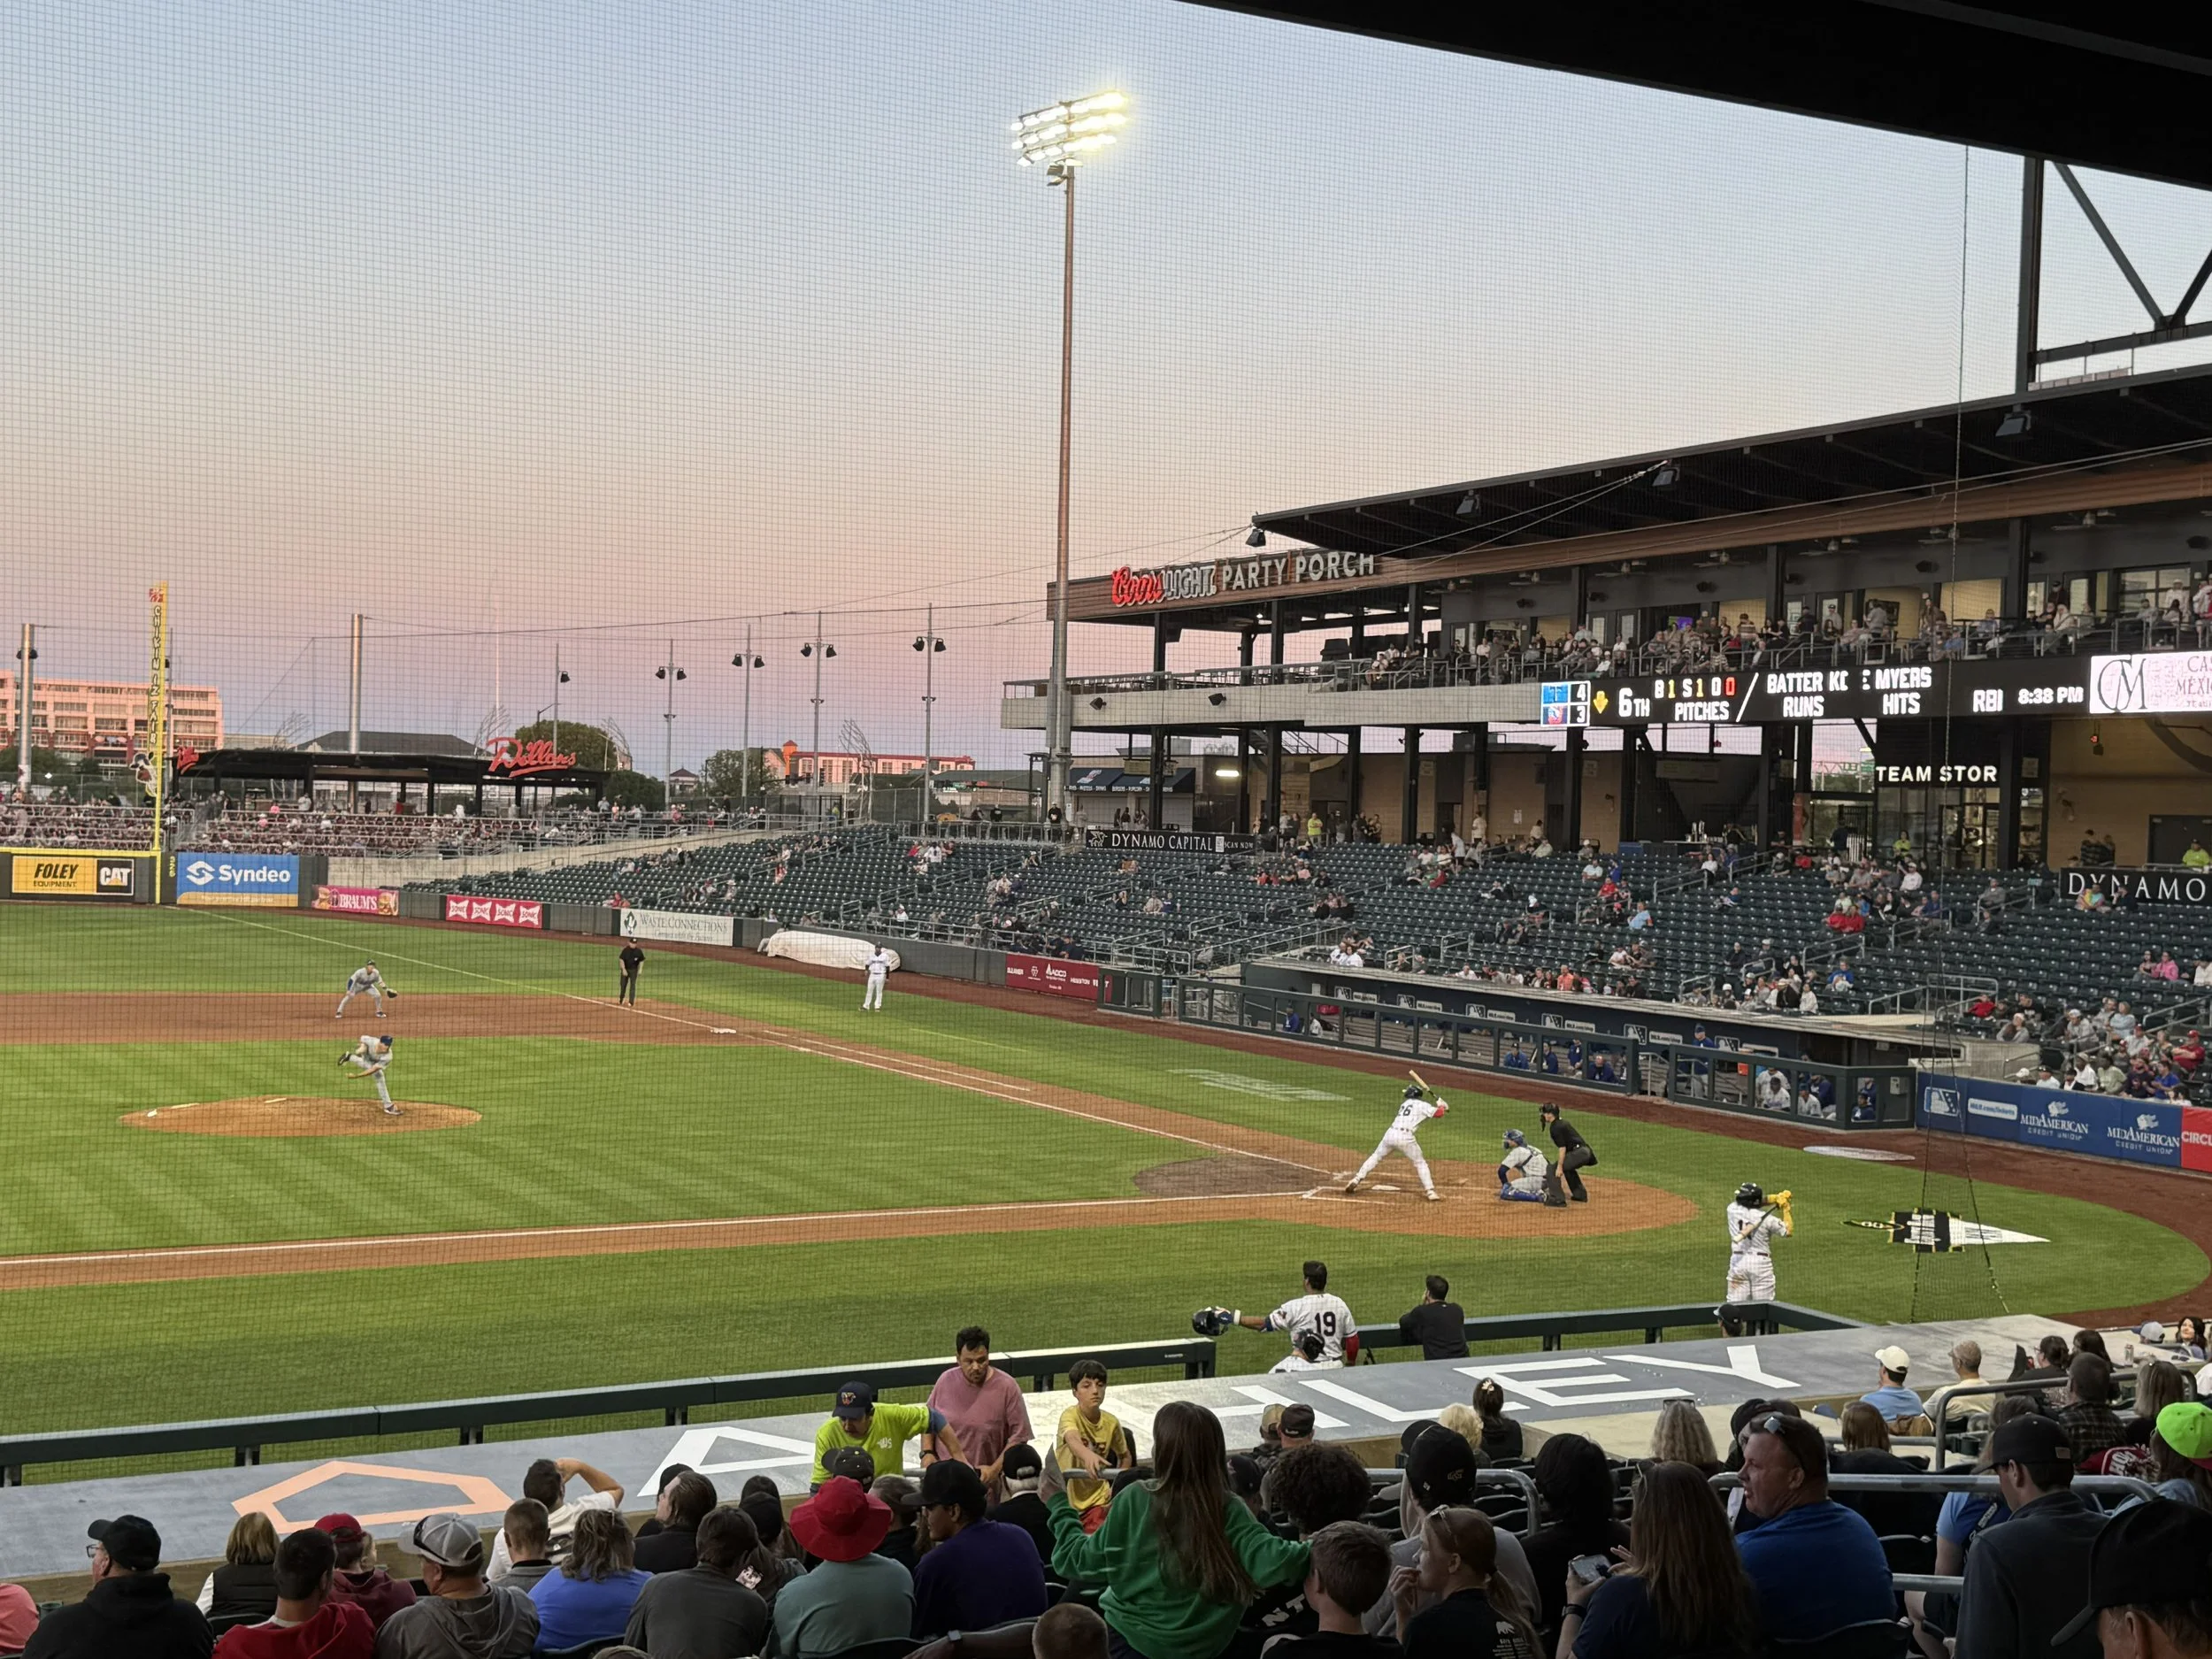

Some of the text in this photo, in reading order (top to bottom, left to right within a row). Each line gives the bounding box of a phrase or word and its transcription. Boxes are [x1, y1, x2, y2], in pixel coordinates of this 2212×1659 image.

[1111, 565, 1164, 607] Coors
[1222, 558, 1289, 591] PARTY
[1294, 551, 1374, 583] PORCH
[151, 604, 162, 671] CHIKIN
[2187, 656, 2212, 672] CA
[150, 673, 160, 696] IZ
[1767, 672, 1824, 694] BATTER
[1875, 666, 1932, 690] MYERS
[2176, 676, 2212, 695] MÉXI
[1577, 683, 1586, 702] 4
[1618, 687, 1650, 718] 6TH
[1972, 688, 2004, 712] RBI
[2017, 687, 2084, 705] 8:38 PM
[1577, 705, 1586, 723] 3
[1675, 701, 1730, 722] PITCHES
[1783, 695, 1824, 718] RUNS
[1883, 692, 1921, 715] HITS
[149, 700, 159, 744] FAIR
[488, 737, 577, 778] Dillons
[1875, 765, 1998, 783] TEAM STOR
[1111, 833, 1213, 851] DYNAMO CAPITAL
[34, 863, 80, 879] FOLEY
[99, 866, 132, 887] CAT
[219, 864, 291, 886] Syndeo
[33, 879, 78, 888] EQUIPMENT
[339, 892, 378, 910] BRAUM'S
[451, 904, 468, 914] SONIC
[640, 913, 727, 933] WASTE CONNECTIONS
[1314, 1311, 1336, 1337] 19
